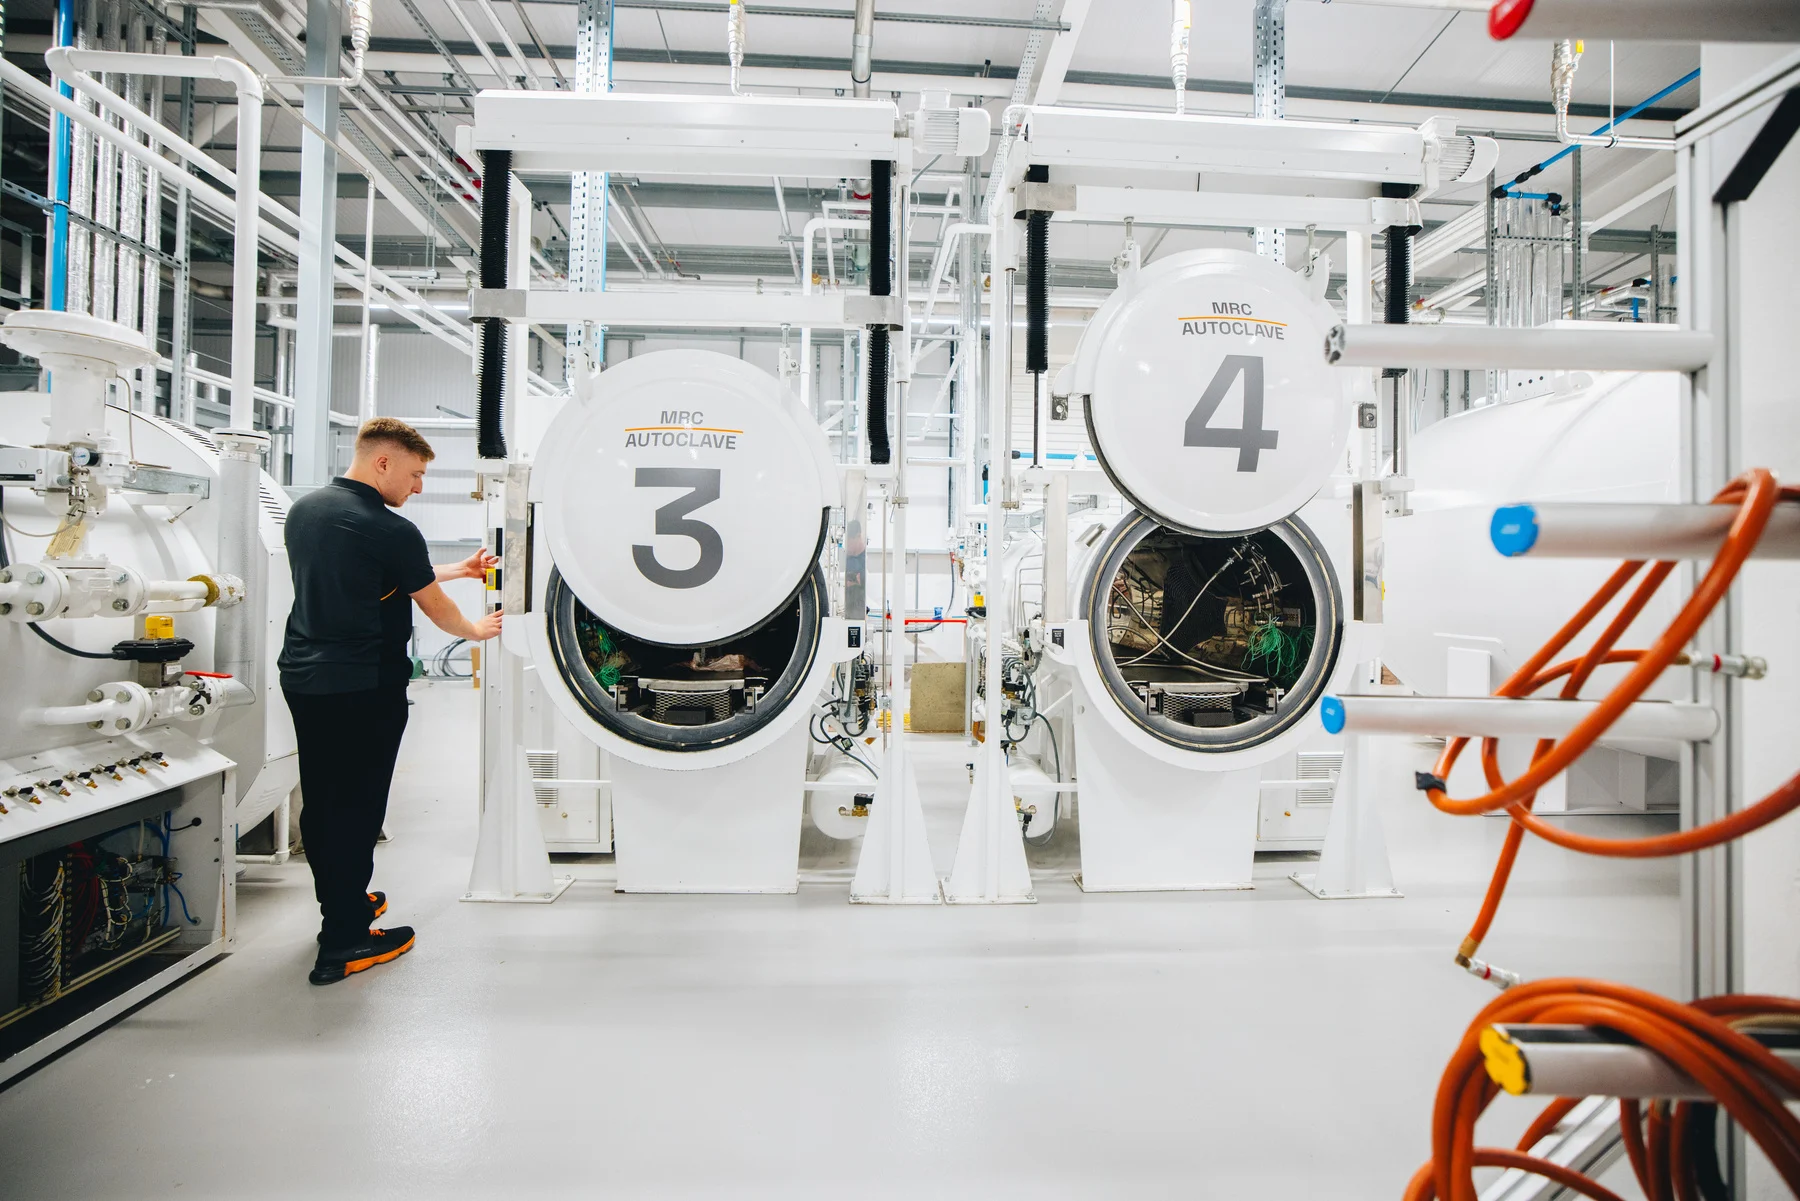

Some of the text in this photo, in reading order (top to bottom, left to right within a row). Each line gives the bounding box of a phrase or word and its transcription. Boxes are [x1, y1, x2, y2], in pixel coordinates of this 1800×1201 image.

[1212, 301, 1252, 316] MRC
[1182, 321, 1285, 341] AUTOCLAVE
[660, 410, 704, 425] MRC
[1184, 355, 1279, 472] 4
[625, 432, 737, 450] AUTOCLAVE
[632, 467, 723, 589] 3
